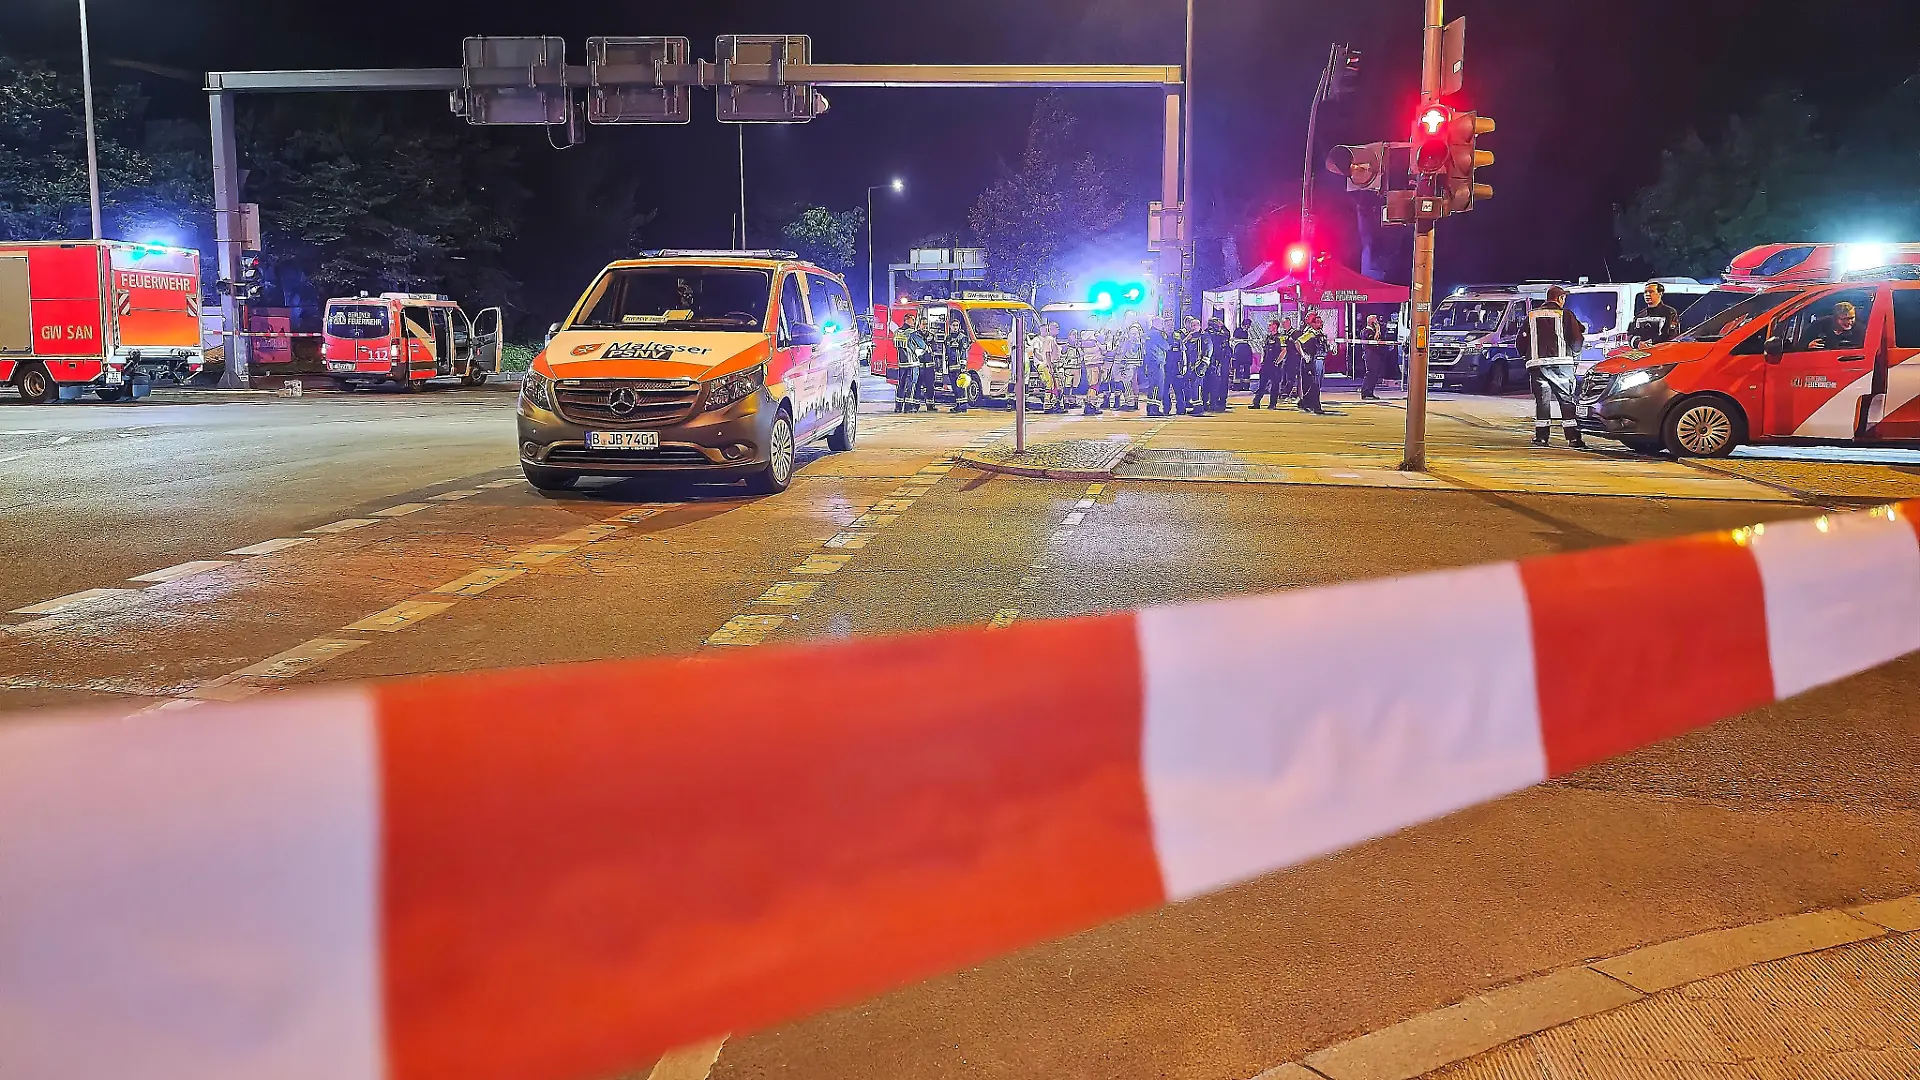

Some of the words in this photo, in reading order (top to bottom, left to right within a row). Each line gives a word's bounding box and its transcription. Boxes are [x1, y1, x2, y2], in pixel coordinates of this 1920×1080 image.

[121, 273, 191, 292] FEUERWEHR
[347, 318, 382, 326] FEUERWEHR
[41, 325, 62, 340] GW
[67, 325, 93, 340] SAN
[607, 350, 667, 359] PSNV
[609, 341, 713, 356] Malteser
[368, 350, 389, 361] 112
[592, 433, 600, 445] B
[608, 433, 623, 445] JB
[625, 433, 657, 445] 7401
